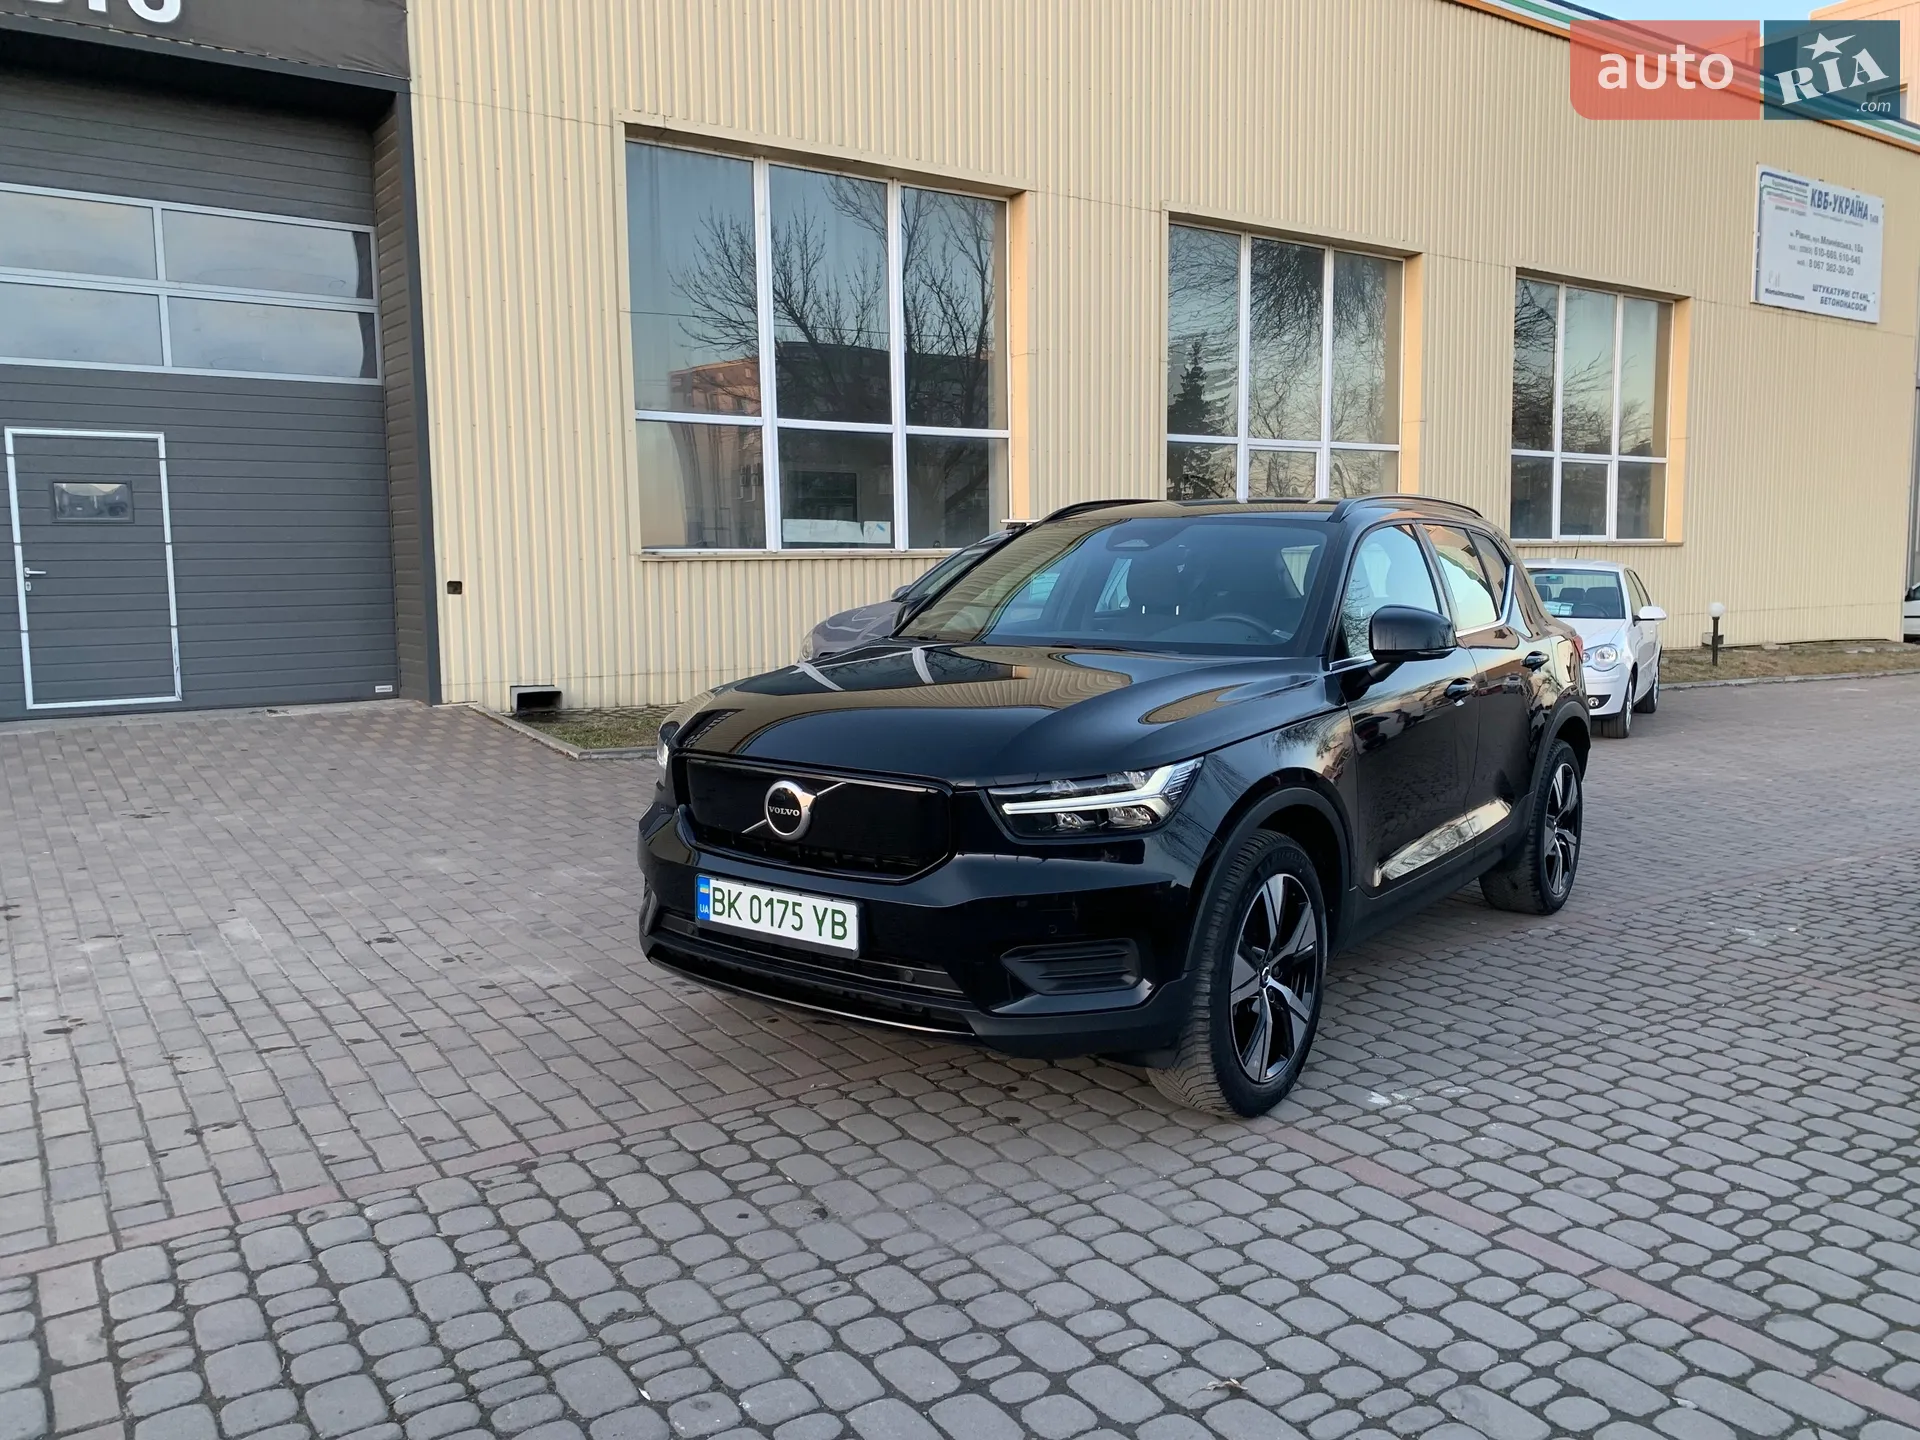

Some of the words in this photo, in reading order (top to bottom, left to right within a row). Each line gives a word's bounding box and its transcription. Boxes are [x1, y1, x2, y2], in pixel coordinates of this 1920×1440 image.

[1810, 188, 1869, 220] КВБ-УКРАЇНА
[1812, 284, 1850, 298] ШТУКАТУРНІ
[1820, 296, 1868, 312] БЕТОНОНАСОСИ
[768, 805, 800, 817] VOLVO
[700, 903, 710, 915] UA
[712, 886, 743, 921] BK
[749, 894, 804, 932] 0175
[812, 904, 848, 941] YB
